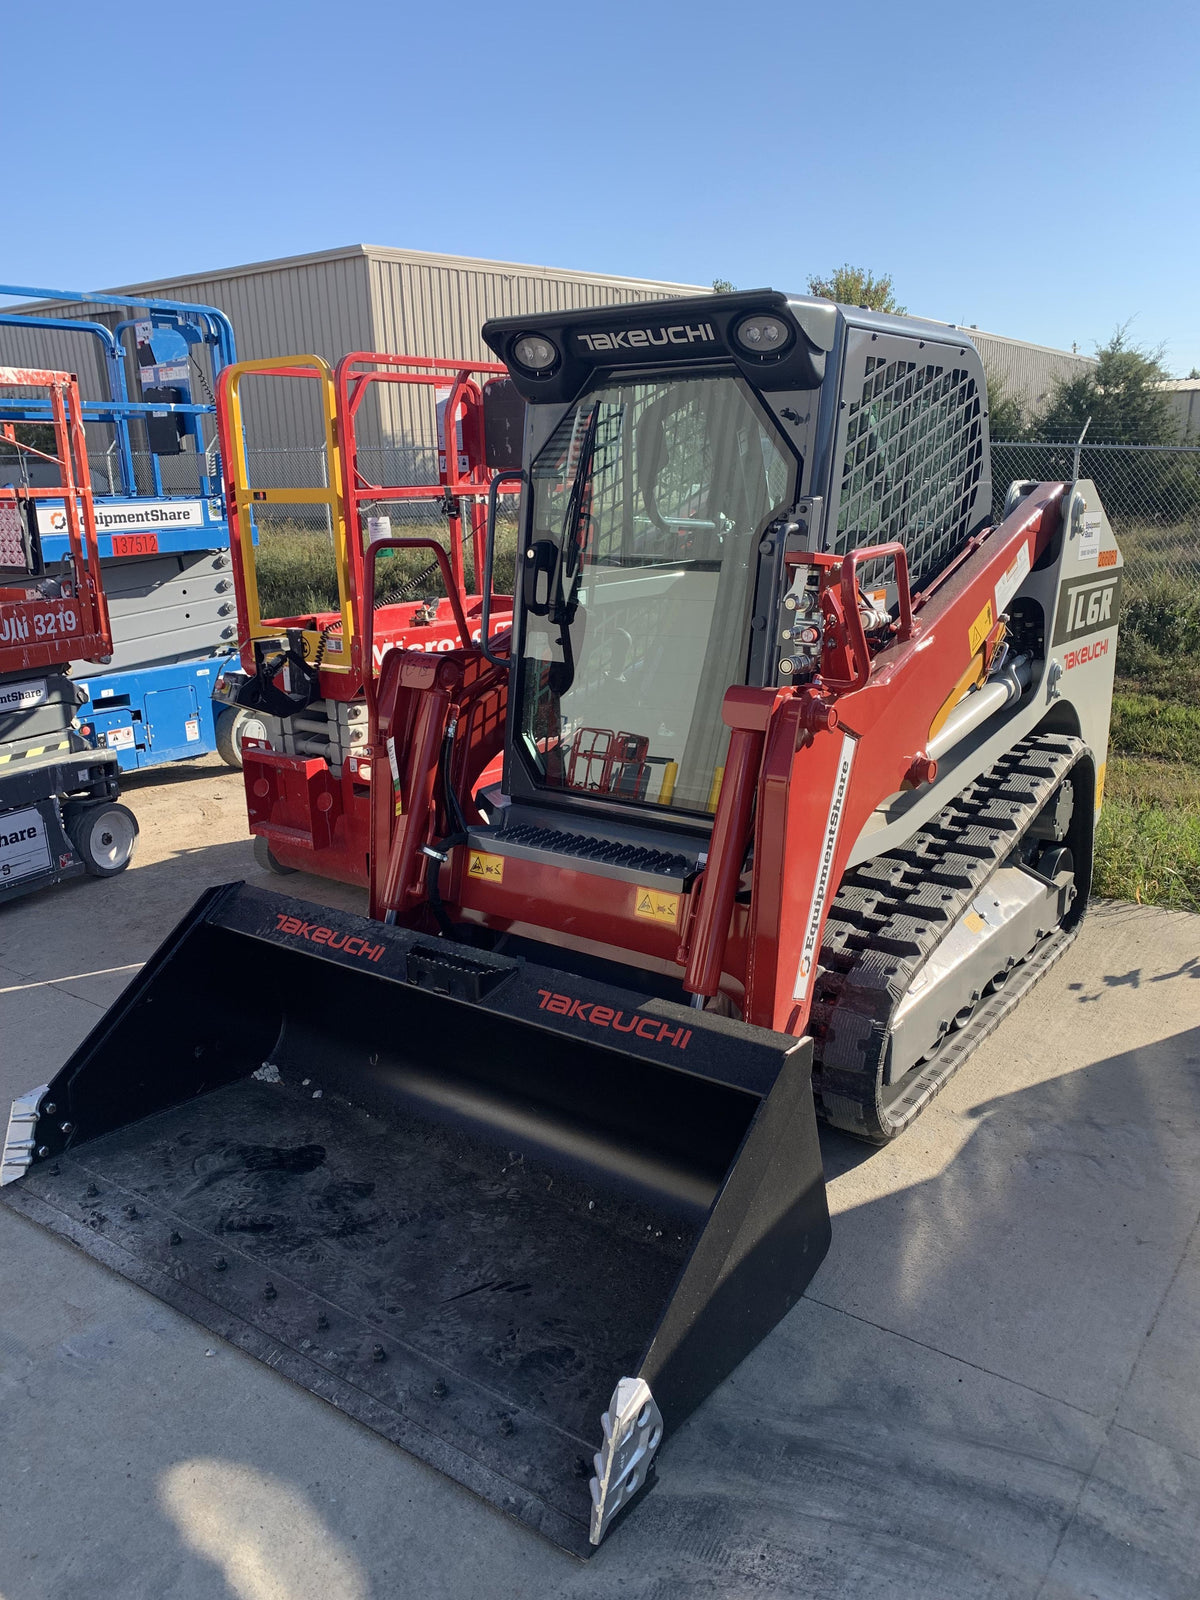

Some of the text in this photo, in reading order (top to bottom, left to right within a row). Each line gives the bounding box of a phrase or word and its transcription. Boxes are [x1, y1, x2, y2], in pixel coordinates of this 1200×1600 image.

[577, 323, 715, 350] TAKEUCHI
[113, 535, 157, 554] 137512
[34, 610, 76, 636] 3219
[1066, 576, 1118, 633] TL6R
[1063, 639, 1109, 671] TAKEUCHI
[804, 760, 848, 951] EquipmentShare
[275, 914, 386, 962] TAKEUCHI
[538, 989, 692, 1049] TAKEUCHI
